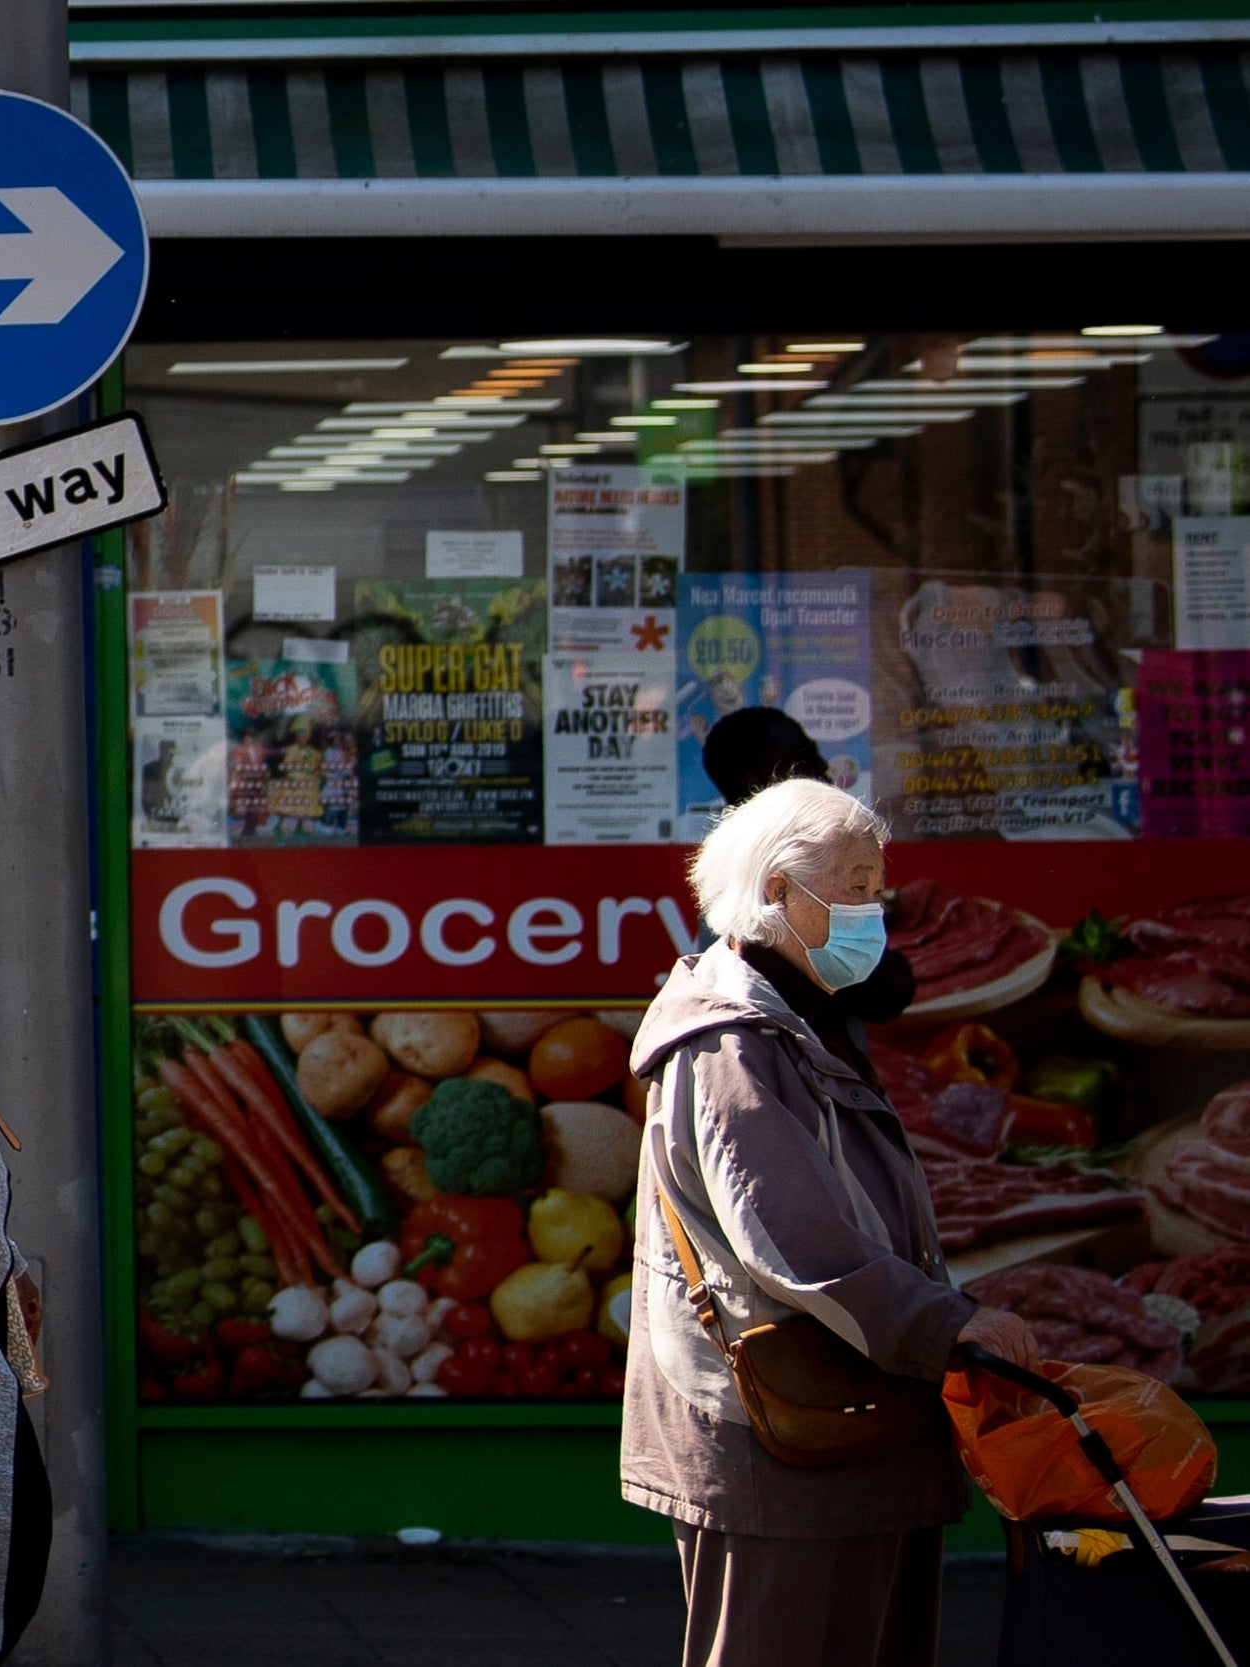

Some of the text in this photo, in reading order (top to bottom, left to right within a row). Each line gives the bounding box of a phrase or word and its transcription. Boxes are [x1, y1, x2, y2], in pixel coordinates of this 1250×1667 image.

[4, 452, 126, 523] way
[379, 642, 524, 693] SUPER CAT
[446, 691, 524, 720] GRIFFITHS
[582, 683, 639, 708] STAY
[554, 708, 670, 735] ANOTHER
[587, 735, 636, 759] DAY
